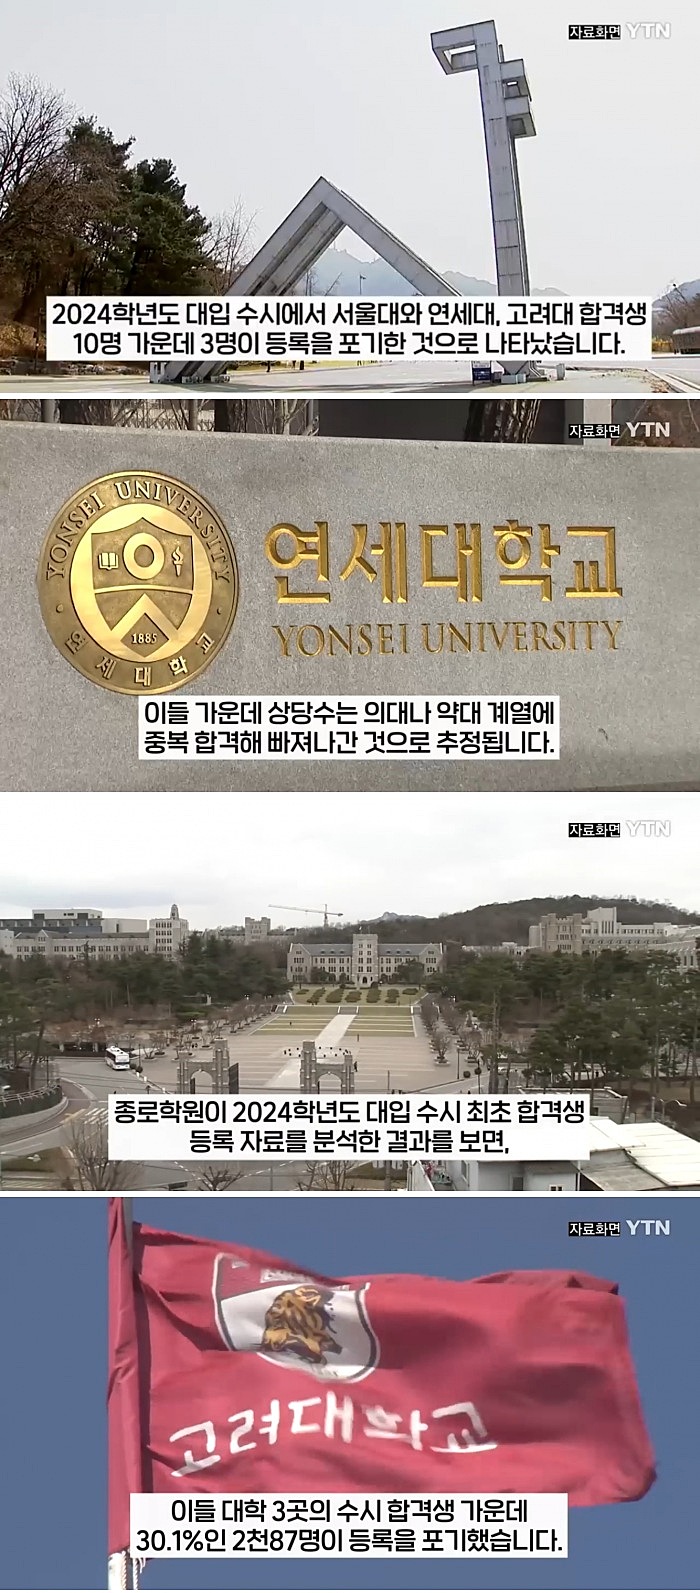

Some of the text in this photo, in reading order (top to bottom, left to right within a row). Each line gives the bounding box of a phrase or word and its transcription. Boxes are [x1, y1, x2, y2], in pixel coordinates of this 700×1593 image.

[46, 480, 230, 584] YONSEI UNIVERSITY
[265, 520, 623, 604] 연세대학교
[131, 632, 158, 645] 1885
[272, 620, 624, 657] YONSEI UNIVERSITY
[169, 1390, 498, 1478] 고려대학교
